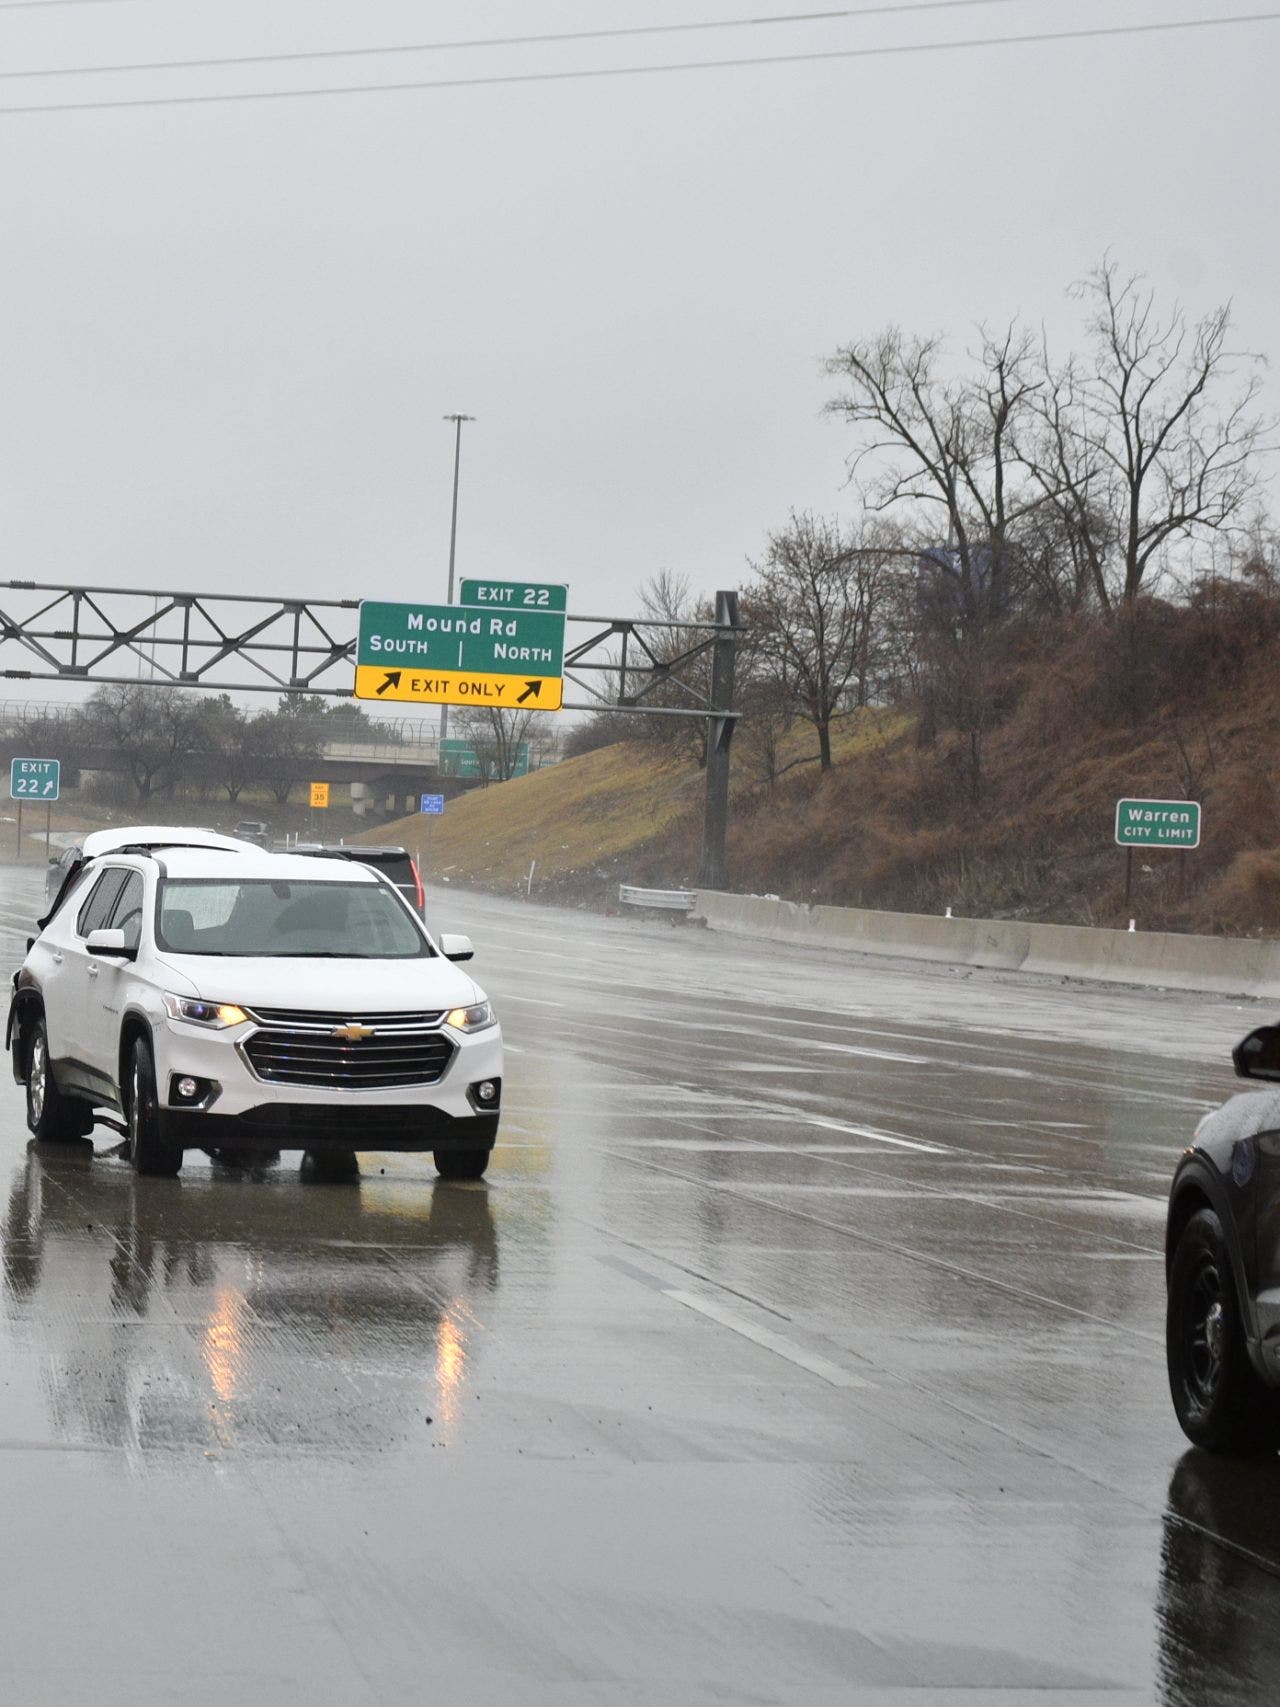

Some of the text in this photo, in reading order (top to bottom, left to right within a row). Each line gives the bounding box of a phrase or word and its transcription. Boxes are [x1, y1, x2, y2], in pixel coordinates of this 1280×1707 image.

[477, 587, 550, 606] EXIT 22
[407, 613, 517, 637] Mound Rd
[370, 635, 552, 662] SOUTH NORTH
[411, 678, 506, 697] EXIT ONLY
[21, 762, 51, 773] EXIT
[17, 778, 38, 794] 22
[1128, 809, 1190, 823] Warren
[1124, 826, 1193, 839] CITY LIMIT
